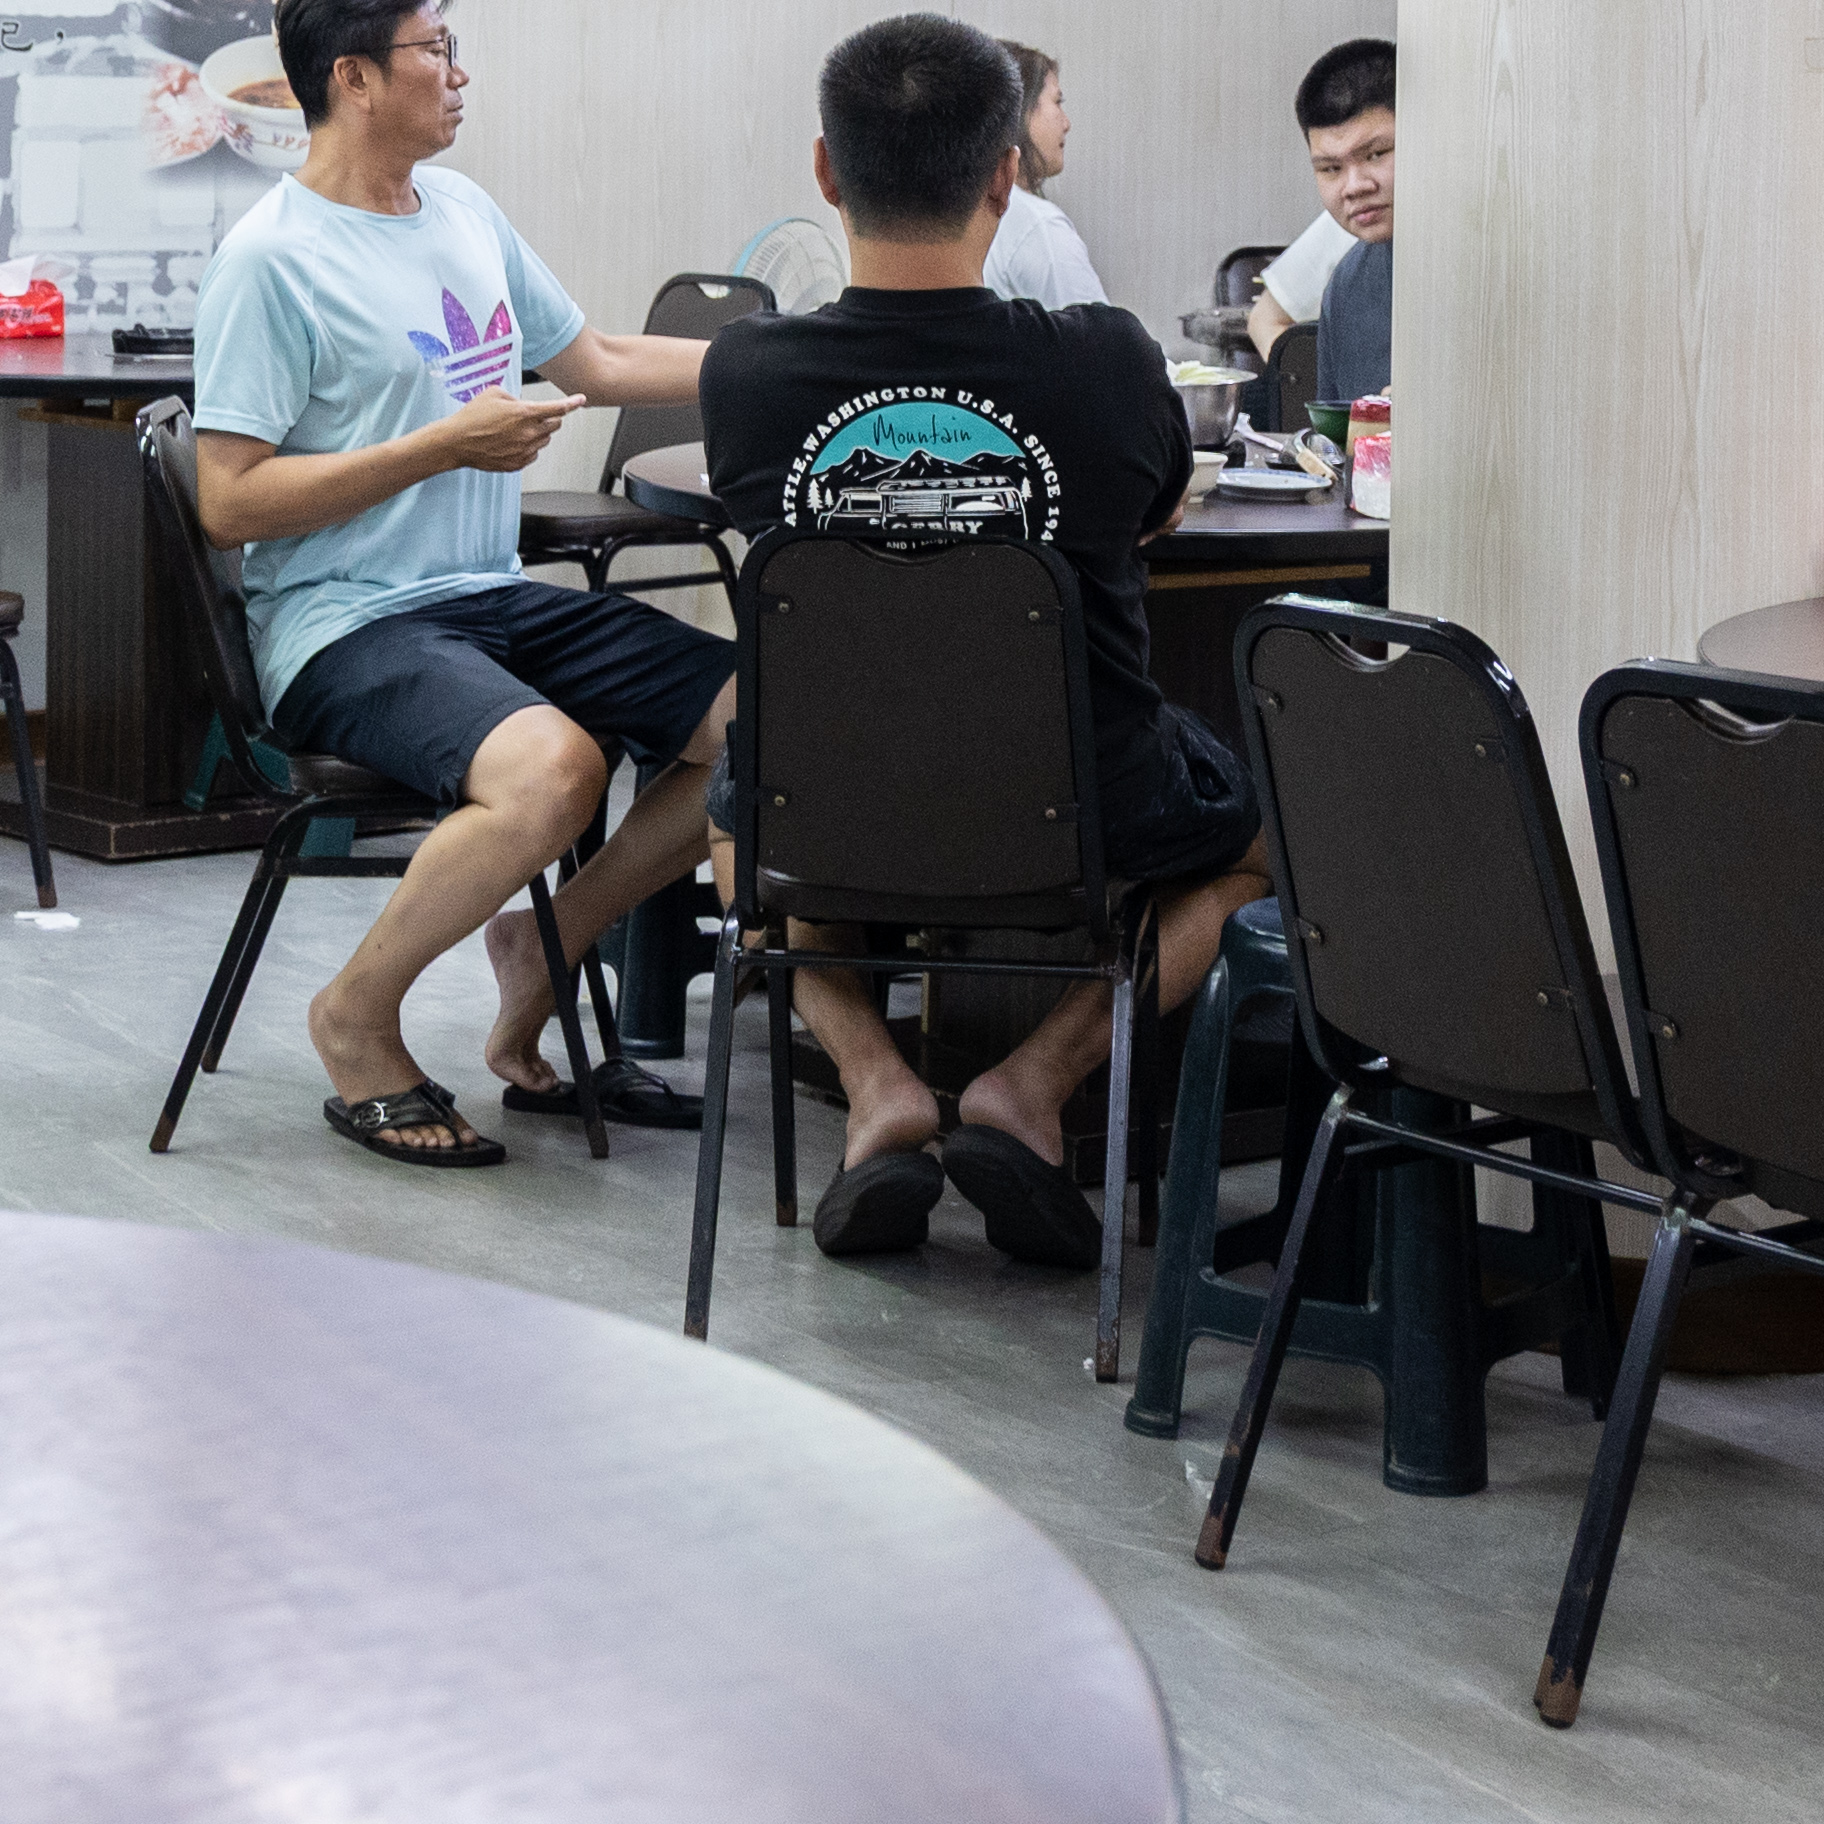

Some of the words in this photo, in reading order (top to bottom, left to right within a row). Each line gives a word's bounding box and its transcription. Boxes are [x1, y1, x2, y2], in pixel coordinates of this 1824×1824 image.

[873, 413, 972, 451] Mountain
[956, 390, 1019, 435] U.S.A.
[1023, 434, 1062, 499] SINCE
[1040, 506, 1060, 545] 194
